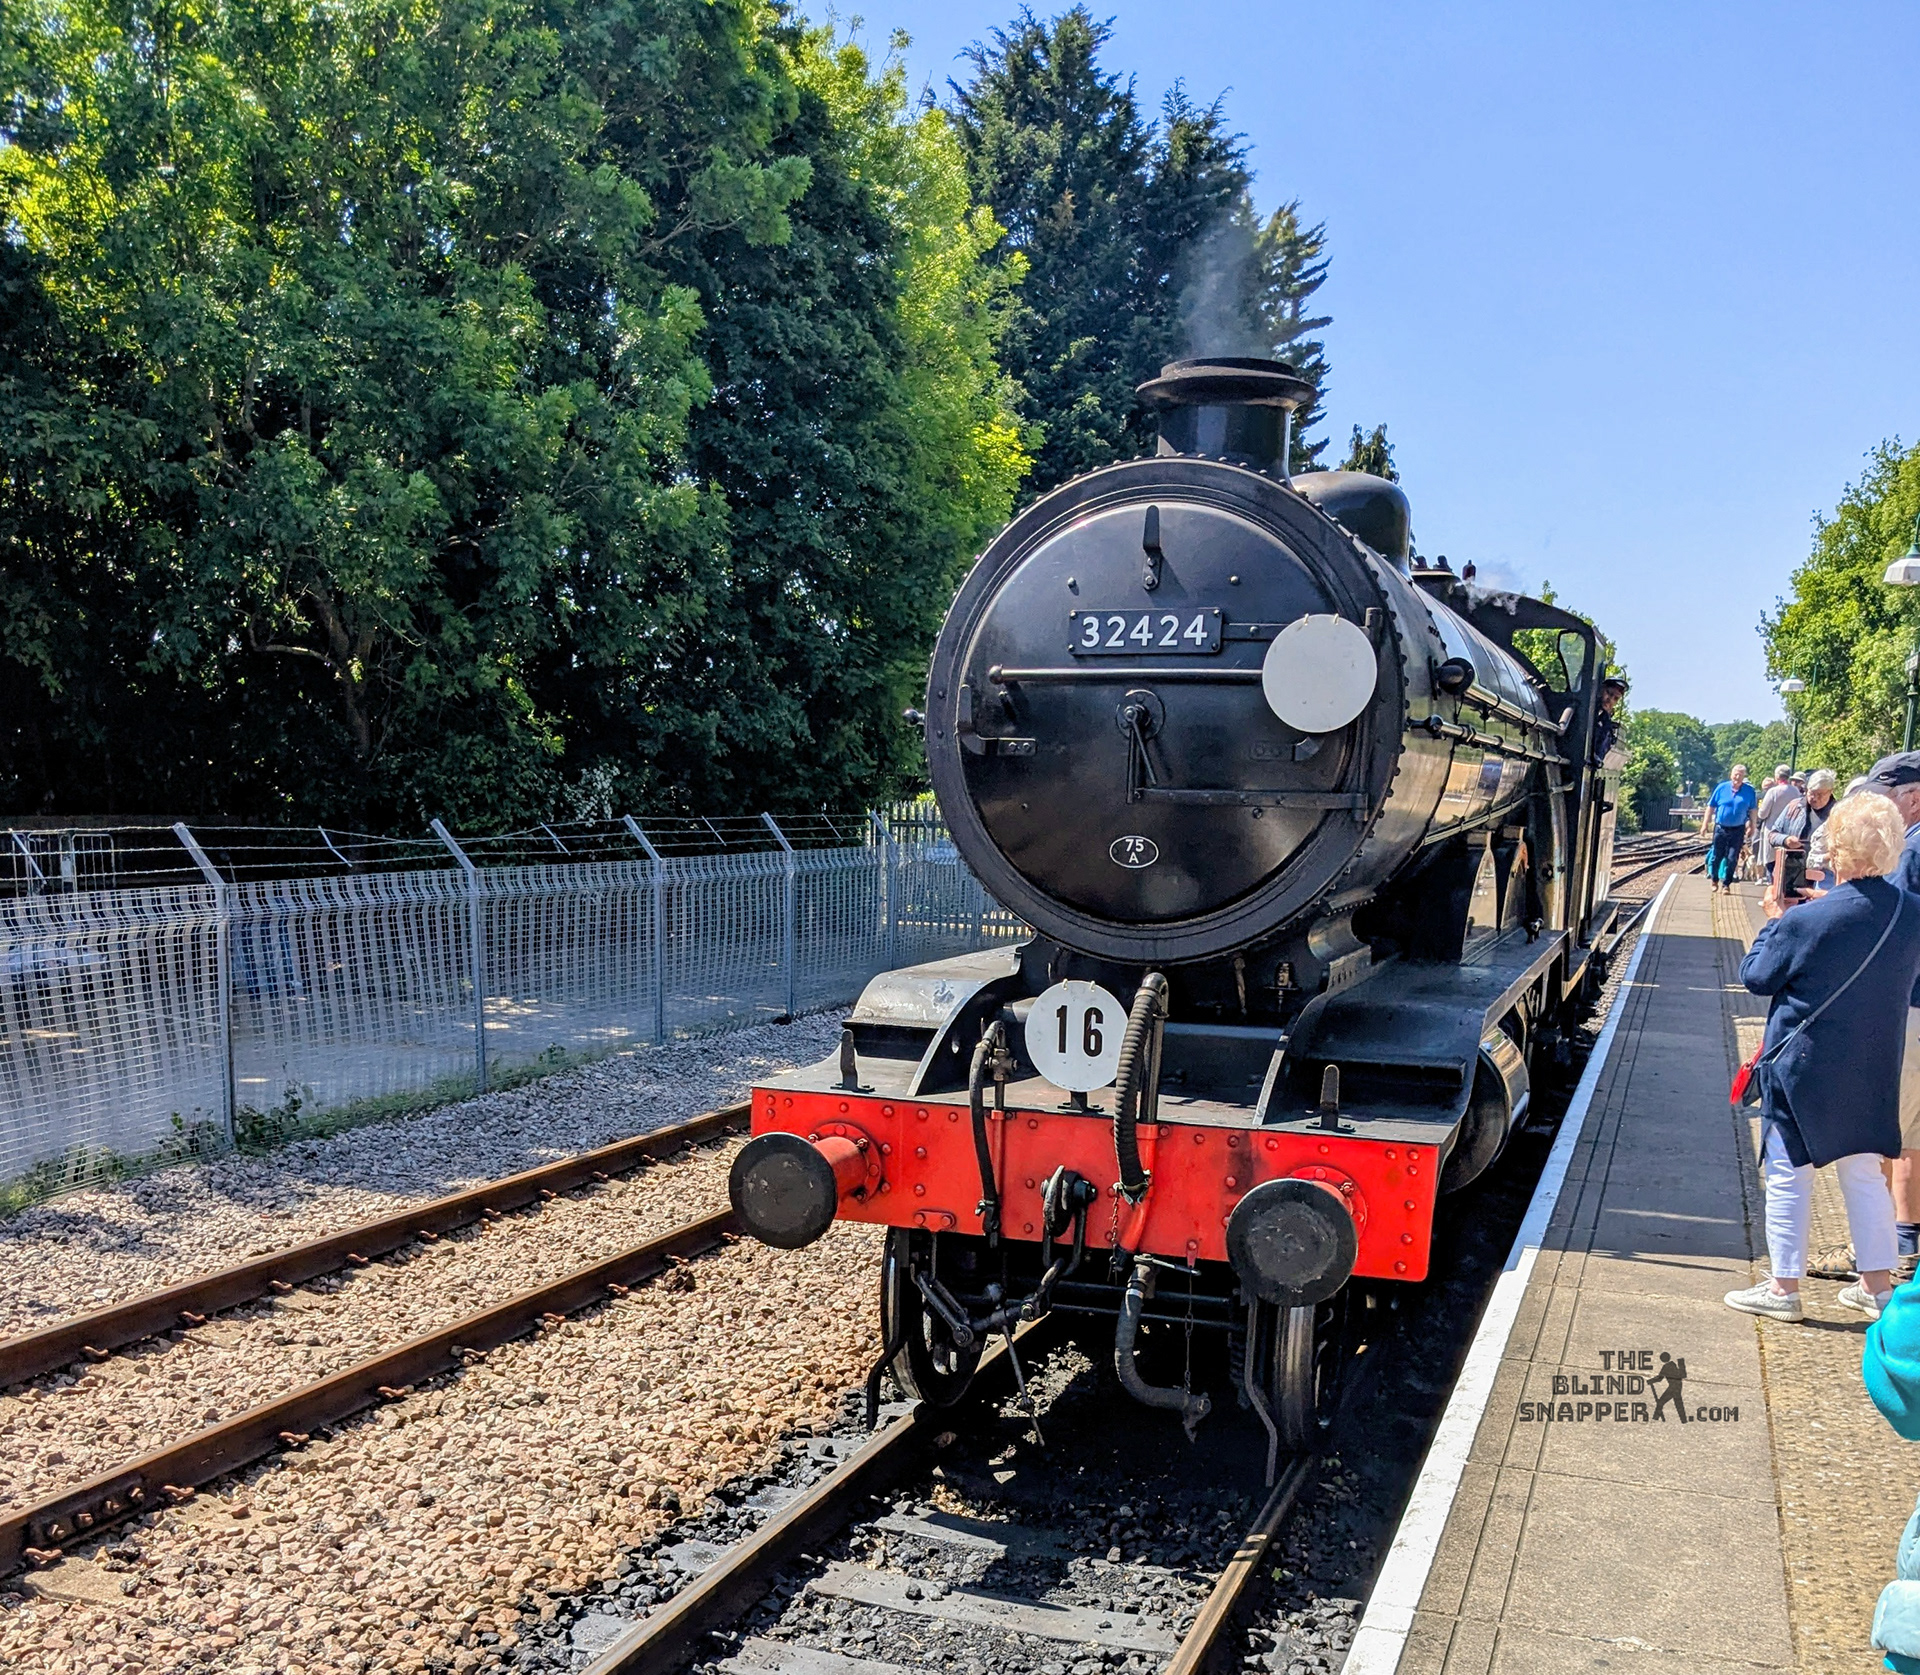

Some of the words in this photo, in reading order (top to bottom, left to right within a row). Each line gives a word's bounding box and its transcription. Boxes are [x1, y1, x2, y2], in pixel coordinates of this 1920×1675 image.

[1081, 614, 1208, 648] 32424
[1125, 838, 1145, 853] 75
[1128, 851, 1139, 864] A
[1056, 1004, 1104, 1058] 16
